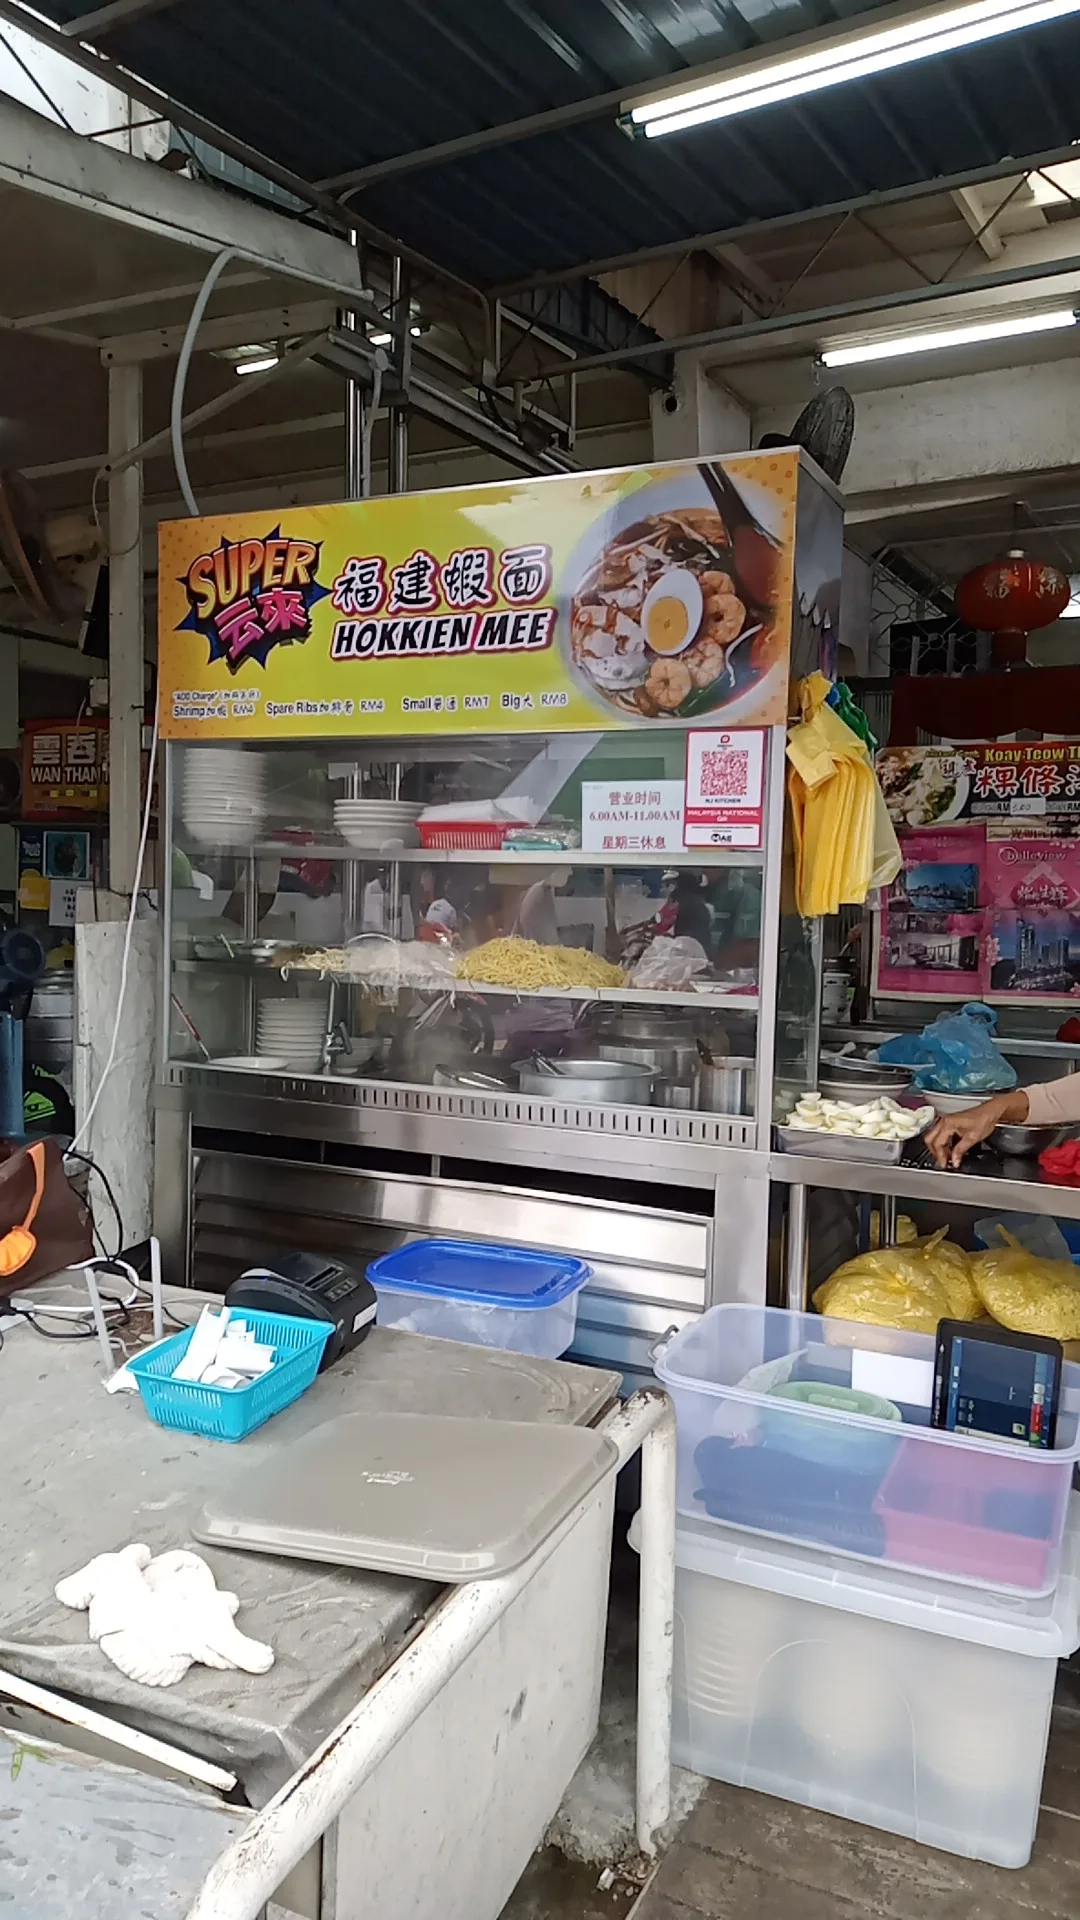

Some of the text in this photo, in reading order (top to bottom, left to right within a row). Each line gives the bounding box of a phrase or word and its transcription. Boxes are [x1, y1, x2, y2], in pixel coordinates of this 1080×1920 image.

[188, 538, 317, 620] SUPER
[334, 547, 547, 611] 福建蝦面
[213, 587, 308, 660] 云來
[334, 612, 549, 654] HOKKIEN MEE
[266, 702, 294, 716] Spare
[296, 701, 318, 714] Ribs
[360, 700, 384, 711] RM4
[402, 697, 432, 710] Small
[464, 696, 489, 708] RM7
[502, 694, 521, 710] Big
[540, 693, 568, 705] RM8
[984, 748, 1022, 763] Koay
[31, 766, 61, 783] WAN
[64, 766, 101, 783] THAN
[609, 790, 661, 806] 营业时间
[589, 810, 680, 822] 6.00AM-11.00AM
[722, 809, 759, 817] NATIONAL
[602, 835, 666, 850] 星期三休息
